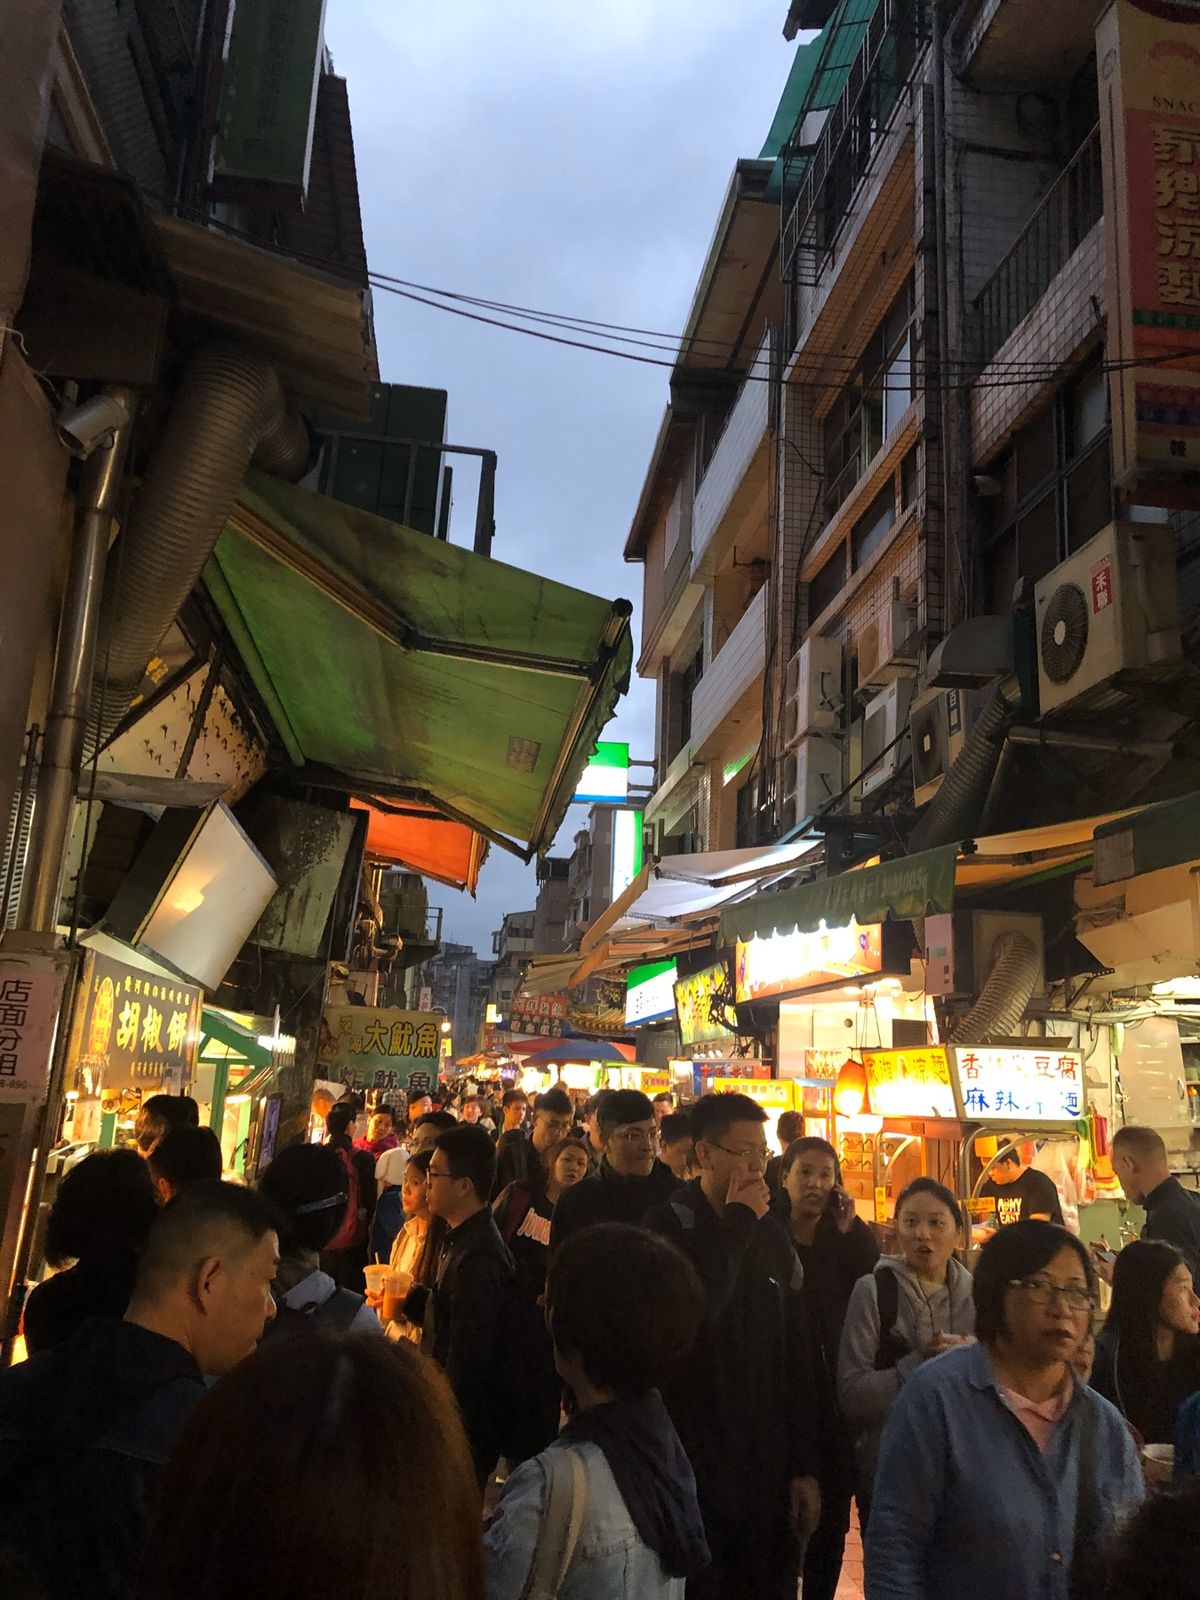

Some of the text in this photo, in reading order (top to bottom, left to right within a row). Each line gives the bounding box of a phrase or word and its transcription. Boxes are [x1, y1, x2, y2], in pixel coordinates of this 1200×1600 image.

[116, 1000, 188, 1057] 胡椒餅
[961, 1053, 1079, 1081] 香豆腐
